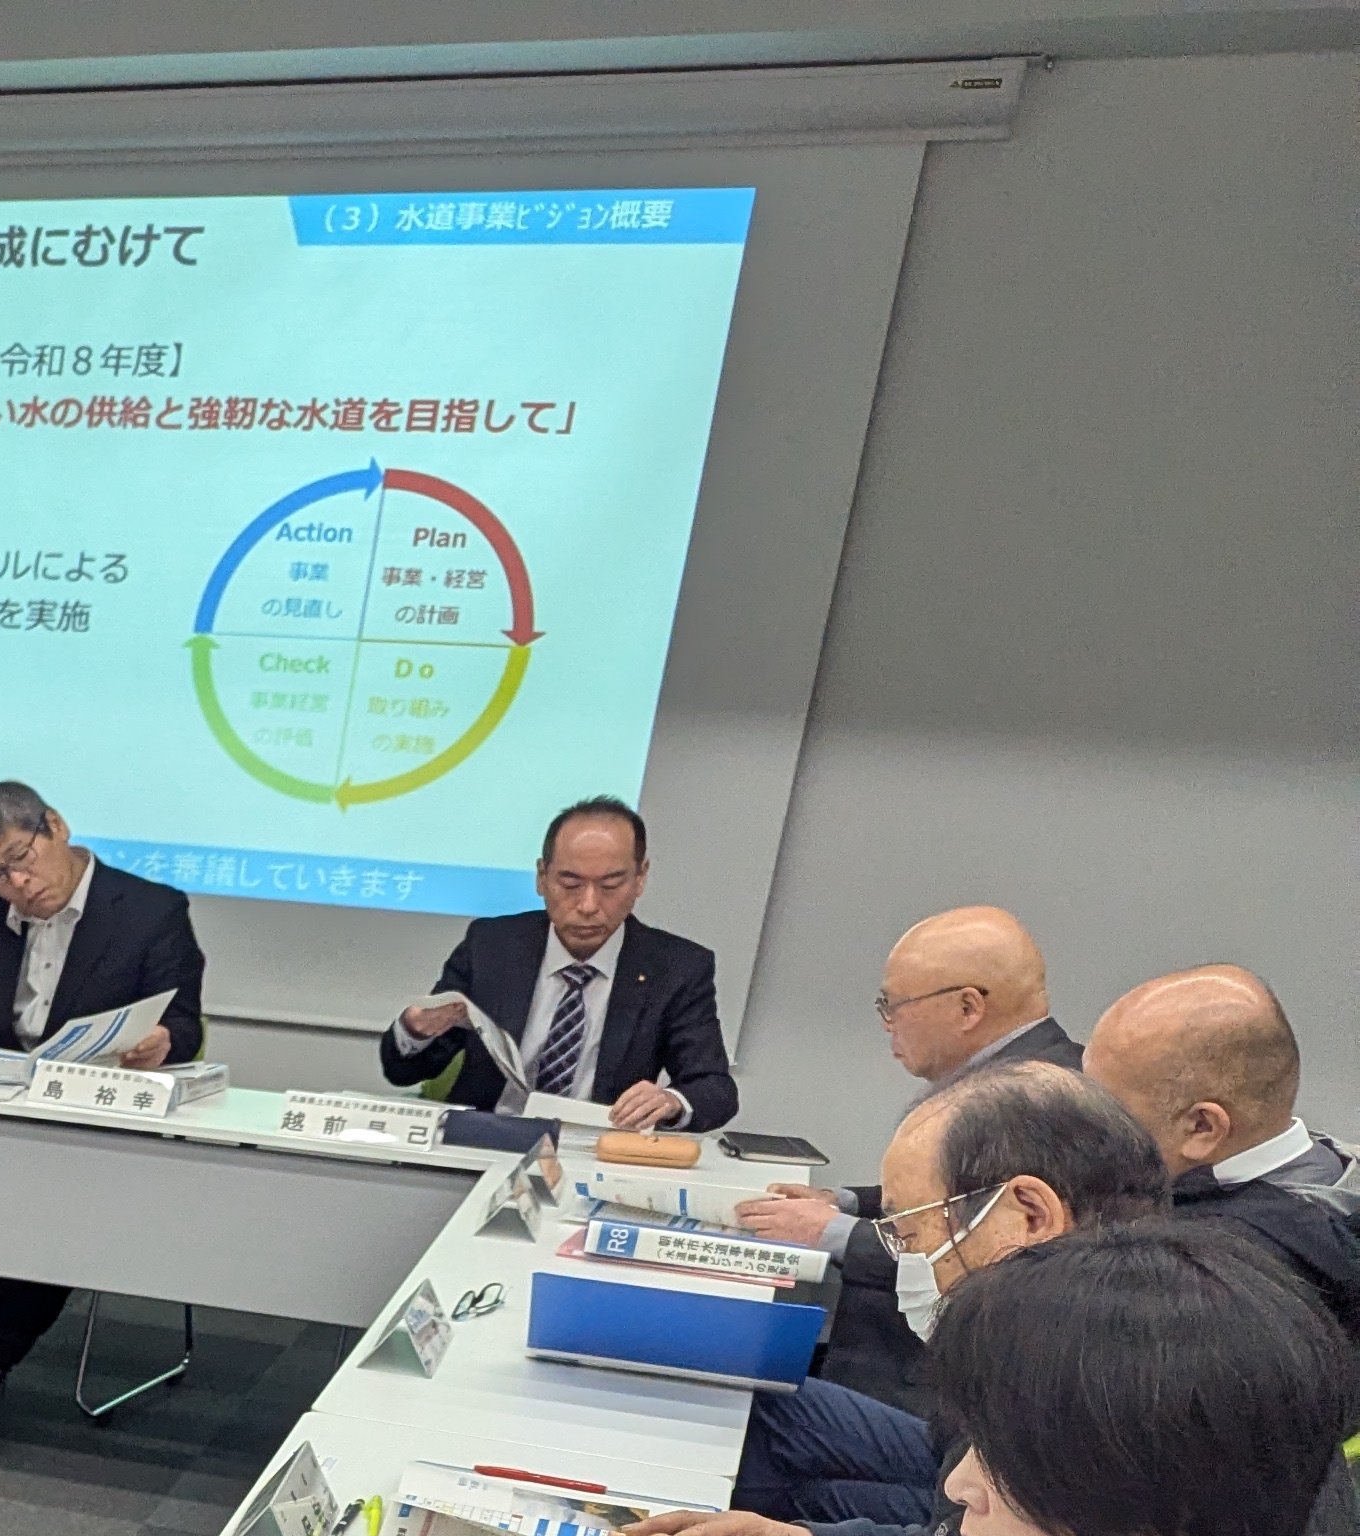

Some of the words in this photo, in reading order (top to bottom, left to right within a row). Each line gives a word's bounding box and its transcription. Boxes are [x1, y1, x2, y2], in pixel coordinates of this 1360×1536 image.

[275, 522, 354, 544] Action
[411, 526, 468, 549] Plan
[288, 561, 330, 582] 事業
[381, 567, 489, 591] 事業・経営
[261, 597, 344, 620] の見直し
[394, 604, 460, 626] の計画
[258, 651, 331, 675] Check
[394, 658, 435, 681] Do
[42, 1078, 156, 1111] 島裕幸
[606, 1227, 630, 1253] R8
